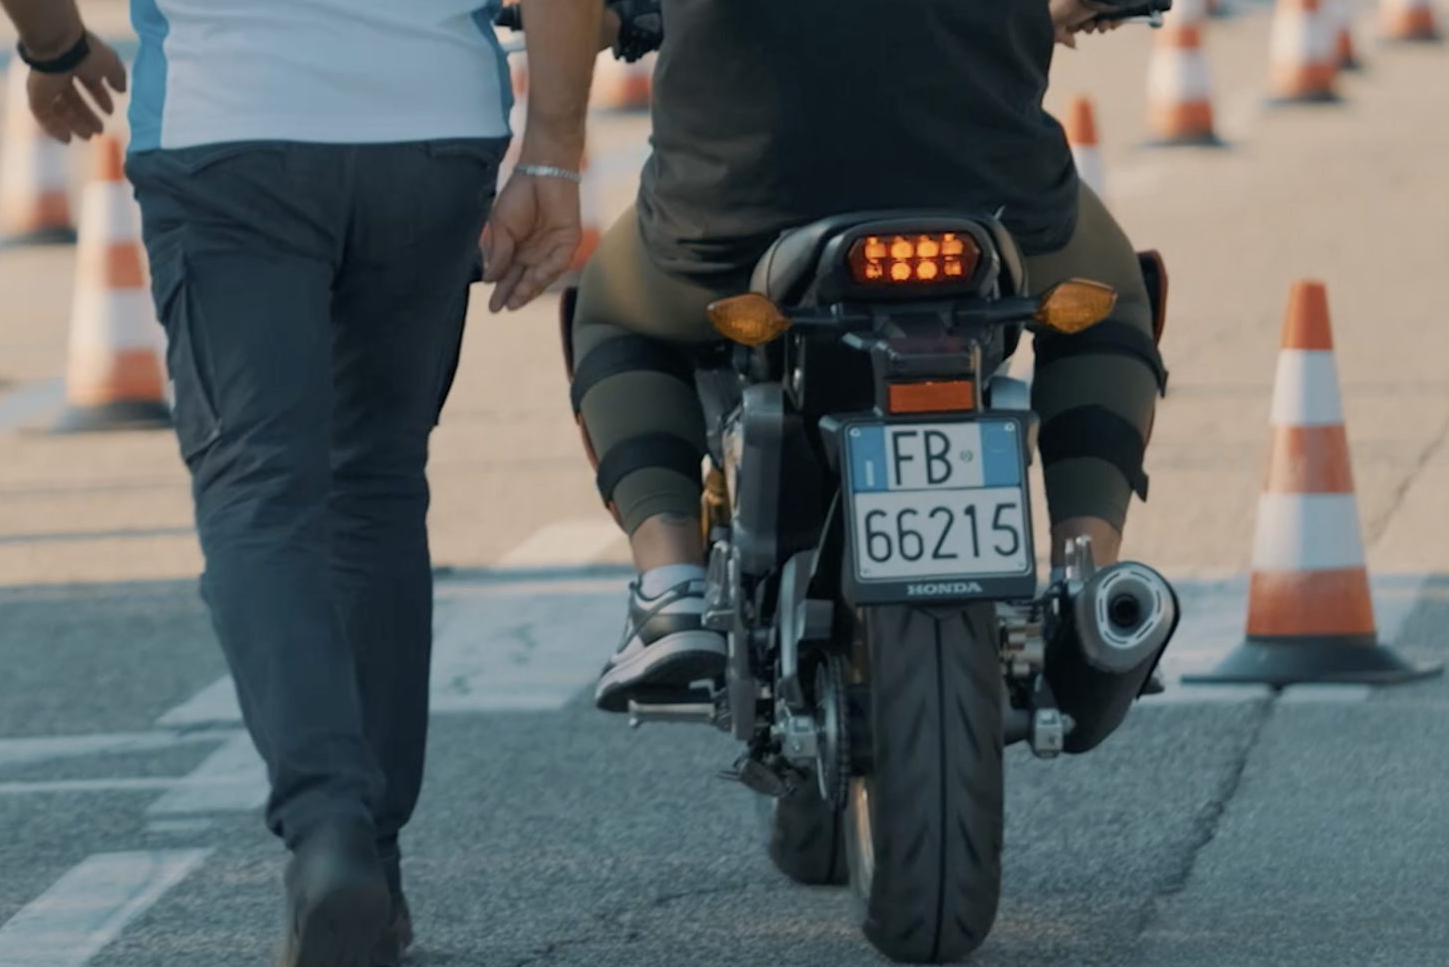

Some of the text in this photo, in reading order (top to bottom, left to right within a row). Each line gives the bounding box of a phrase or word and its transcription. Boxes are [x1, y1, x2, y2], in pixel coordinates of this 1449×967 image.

[892, 430, 953, 486] FB
[865, 503, 1019, 562] 66215
[907, 583, 983, 596] HONDA
